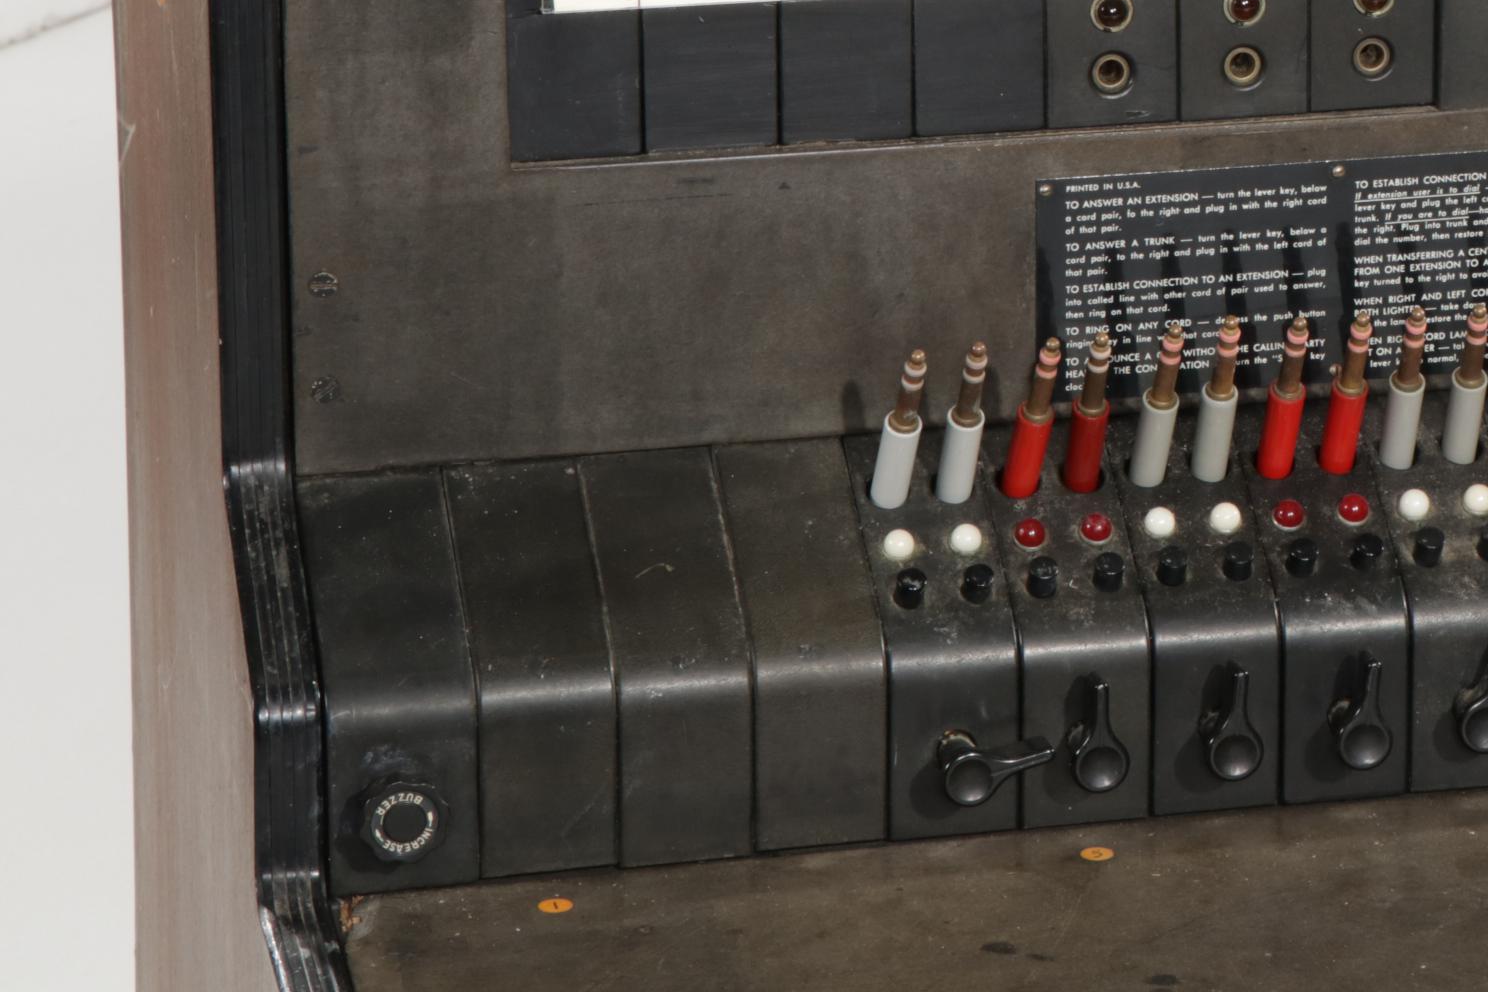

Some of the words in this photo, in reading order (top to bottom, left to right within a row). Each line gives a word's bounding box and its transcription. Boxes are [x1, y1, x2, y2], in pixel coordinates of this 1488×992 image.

[1065, 183, 1099, 192] PRINTED
[1116, 181, 1140, 189] U.S.A.
[1354, 180, 1368, 189] TO
[1372, 177, 1418, 188] ESTABLISH
[1422, 172, 1486, 184] CONNECTION
[1065, 200, 1079, 209] TO
[1082, 197, 1123, 208] ANSWER
[1126, 196, 1141, 205] AN
[1145, 192, 1198, 204] EXTENSION
[1237, 189, 1251, 197] the
[1254, 188, 1275, 196] lever
[1279, 186, 1297, 195] key,
[1301, 184, 1327, 193] below
[1065, 242, 1079, 251] TO
[1084, 239, 1125, 250] ANSWER
[1144, 236, 1174, 245] TRUNK
[1354, 255, 1382, 264] WHEN
[1386, 249, 1454, 261] TRANSFERRING
[1065, 284, 1079, 293] TO
[1082, 281, 1129, 292] ESTABLISH
[1132, 276, 1198, 289] CONNECTION
[1201, 274, 1215, 283] TO
[1218, 274, 1233, 282] AN
[1236, 269, 1288, 281] EXTENSION
[1307, 267, 1326, 277] plug
[1353, 296, 1382, 305] WHEN
[1388, 293, 1416, 303] RIGHT
[1421, 291, 1442, 301] AND
[1447, 289, 1466, 299] LEFT
[375, 793, 423, 816] BUZZER
[382, 828, 434, 853] INCREASE
